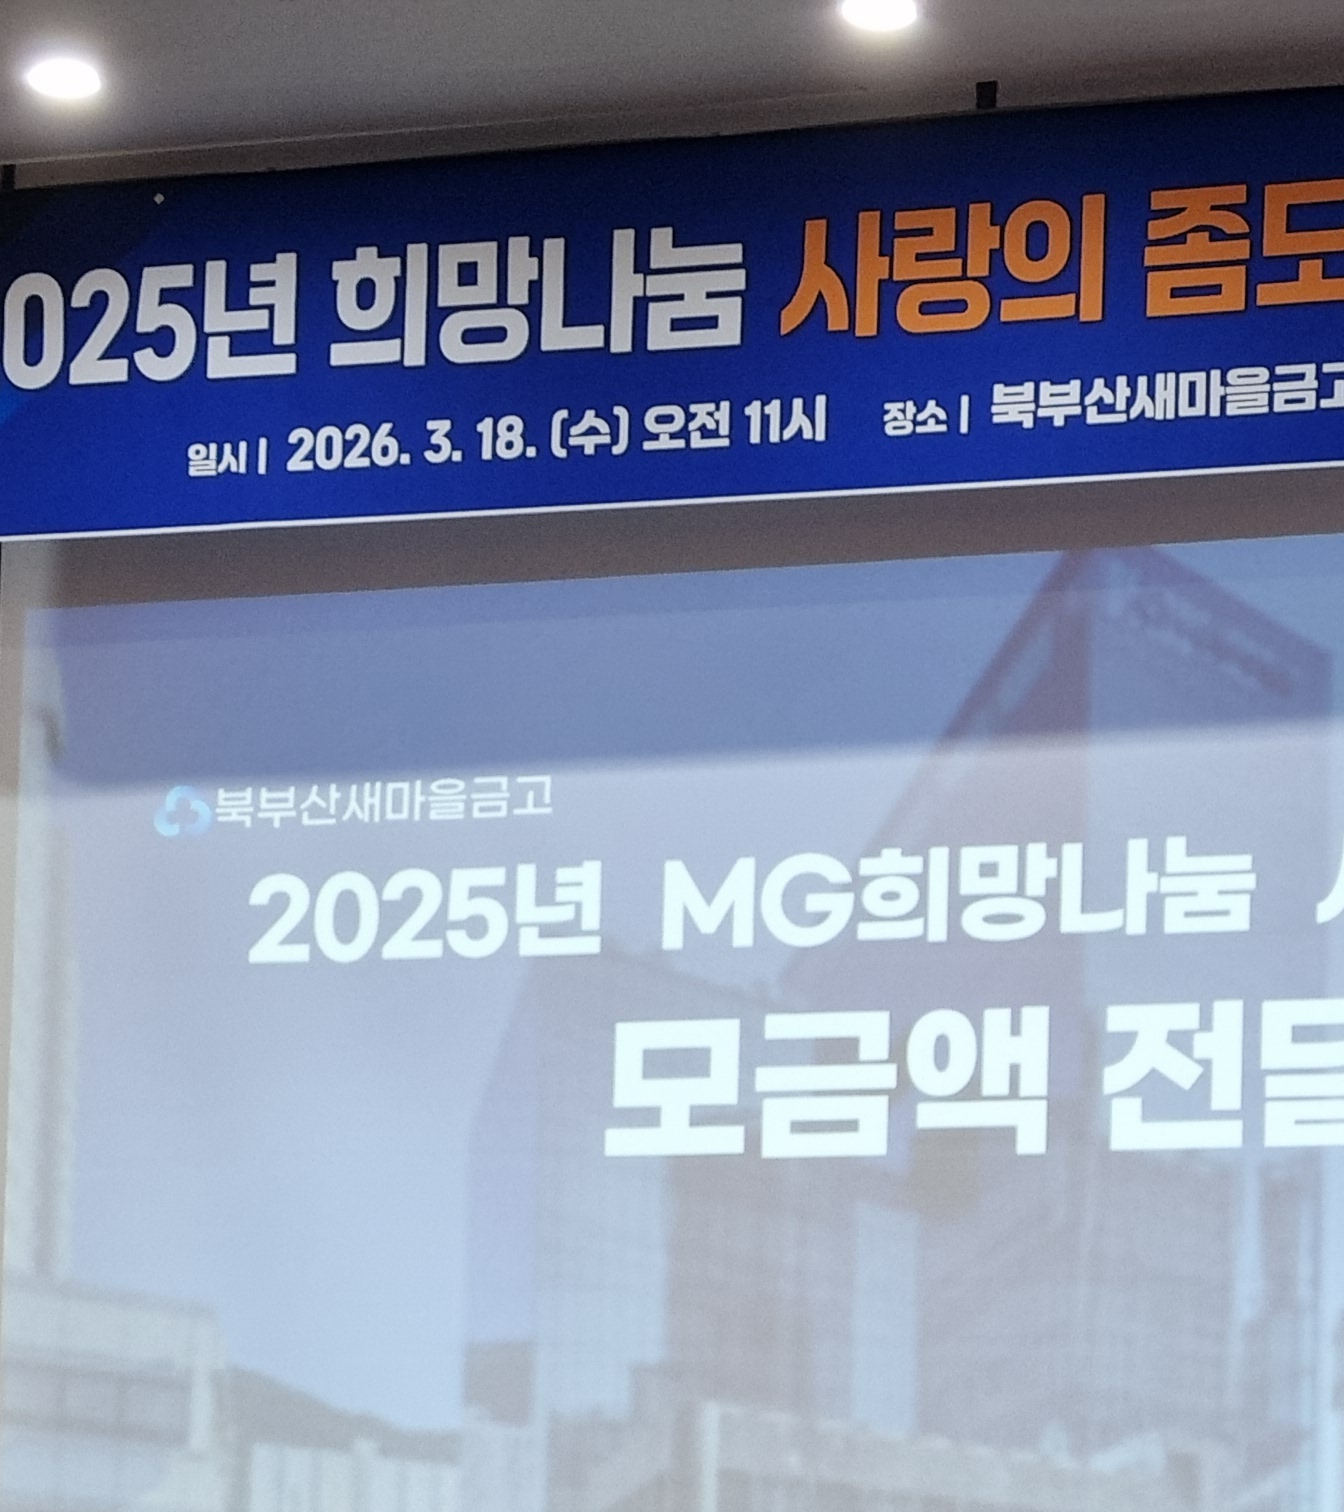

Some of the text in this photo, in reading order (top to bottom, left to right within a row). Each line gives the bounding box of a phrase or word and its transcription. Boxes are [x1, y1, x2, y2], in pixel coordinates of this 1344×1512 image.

[328, 226, 747, 368] 희망나눔
[780, 193, 1106, 337] 사랑의
[187, 441, 247, 478] 일시
[286, 422, 411, 473] 2026.
[424, 420, 462, 464] 3.
[475, 416, 537, 461] 18.
[550, 404, 630, 460] (수)
[642, 400, 731, 452] 오전
[744, 395, 828, 444] 11시
[882, 400, 949, 437] 장소
[214, 775, 554, 829] 북부산새마을금고
[248, 859, 602, 965] 2025년
[661, 835, 1256, 951] MG희망나눔
[603, 1005, 1051, 1160] 모금액
